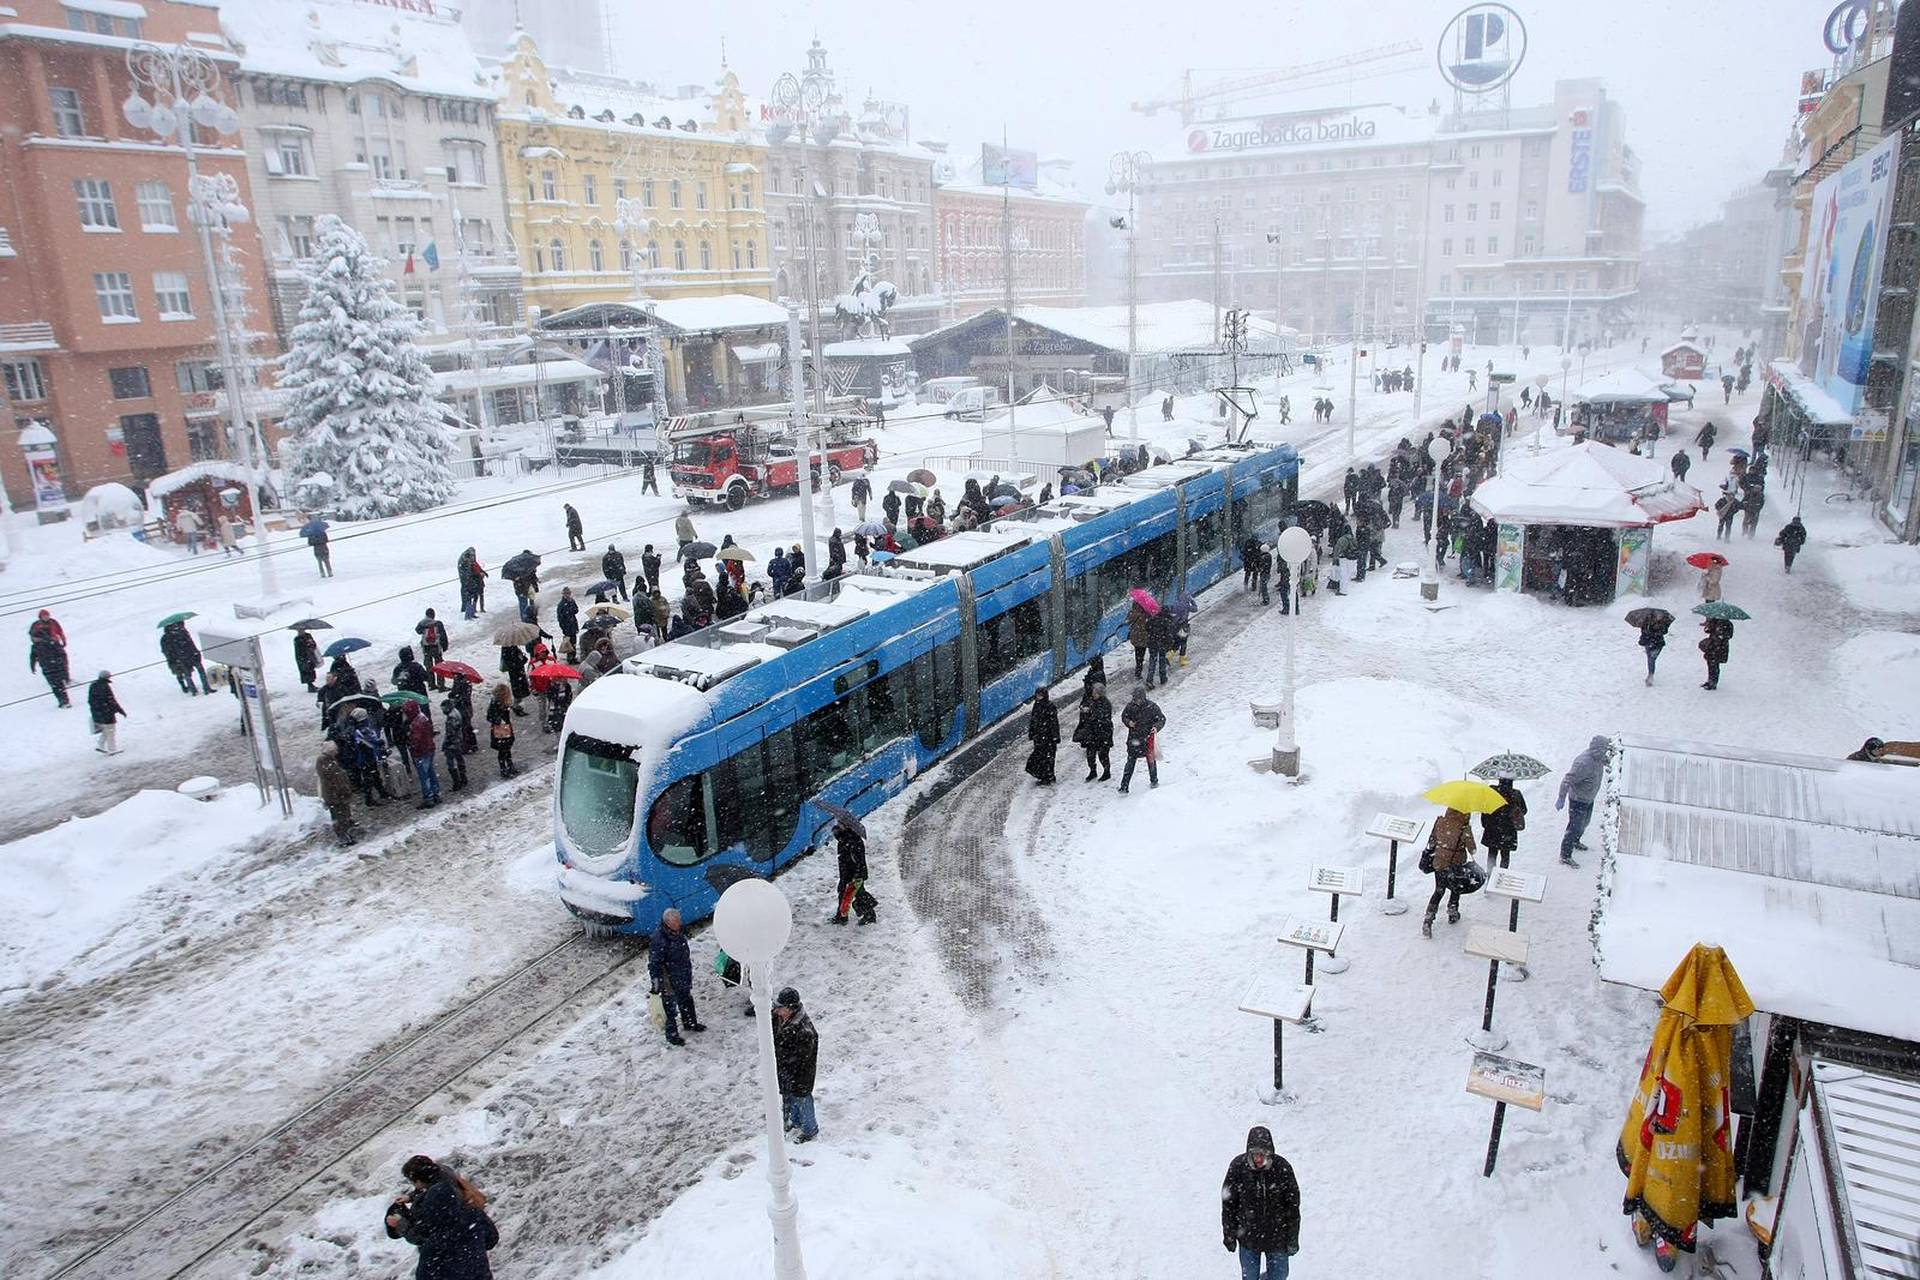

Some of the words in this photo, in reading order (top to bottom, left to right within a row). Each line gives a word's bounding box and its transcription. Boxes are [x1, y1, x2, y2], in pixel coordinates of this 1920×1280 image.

[1212, 123, 1313, 151] Zagrebačka
[1317, 116, 1376, 141] banka
[1568, 130, 1592, 193] ERSTE
